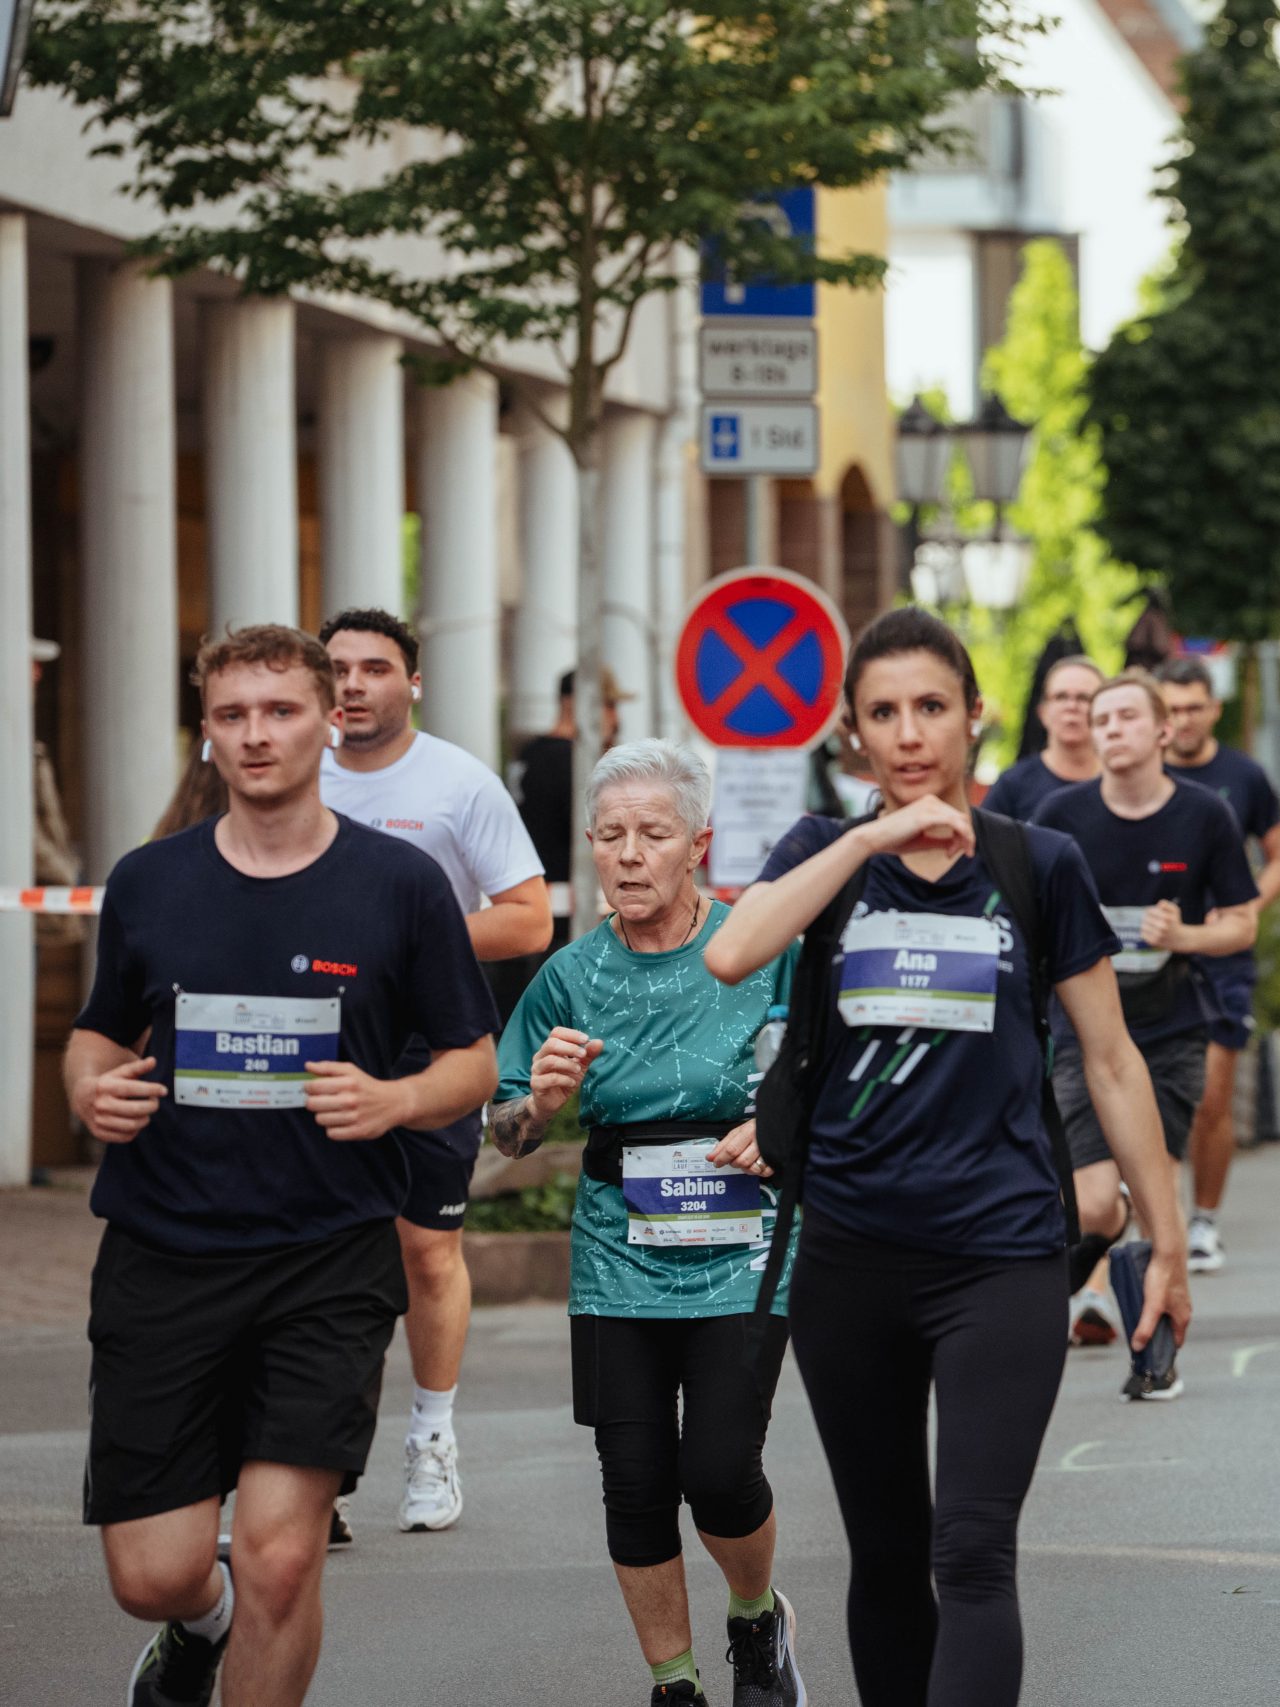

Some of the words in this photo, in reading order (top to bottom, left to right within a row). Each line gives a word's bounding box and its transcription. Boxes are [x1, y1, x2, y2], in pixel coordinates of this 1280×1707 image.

[386, 818, 424, 831] BOSCH
[312, 959, 358, 977] BOSCH
[893, 949, 937, 971] Ana
[900, 974, 930, 988] 1177
[215, 1032, 300, 1055] Bastian
[660, 1178, 726, 1197] Sabine
[680, 1201, 707, 1211] 3204
